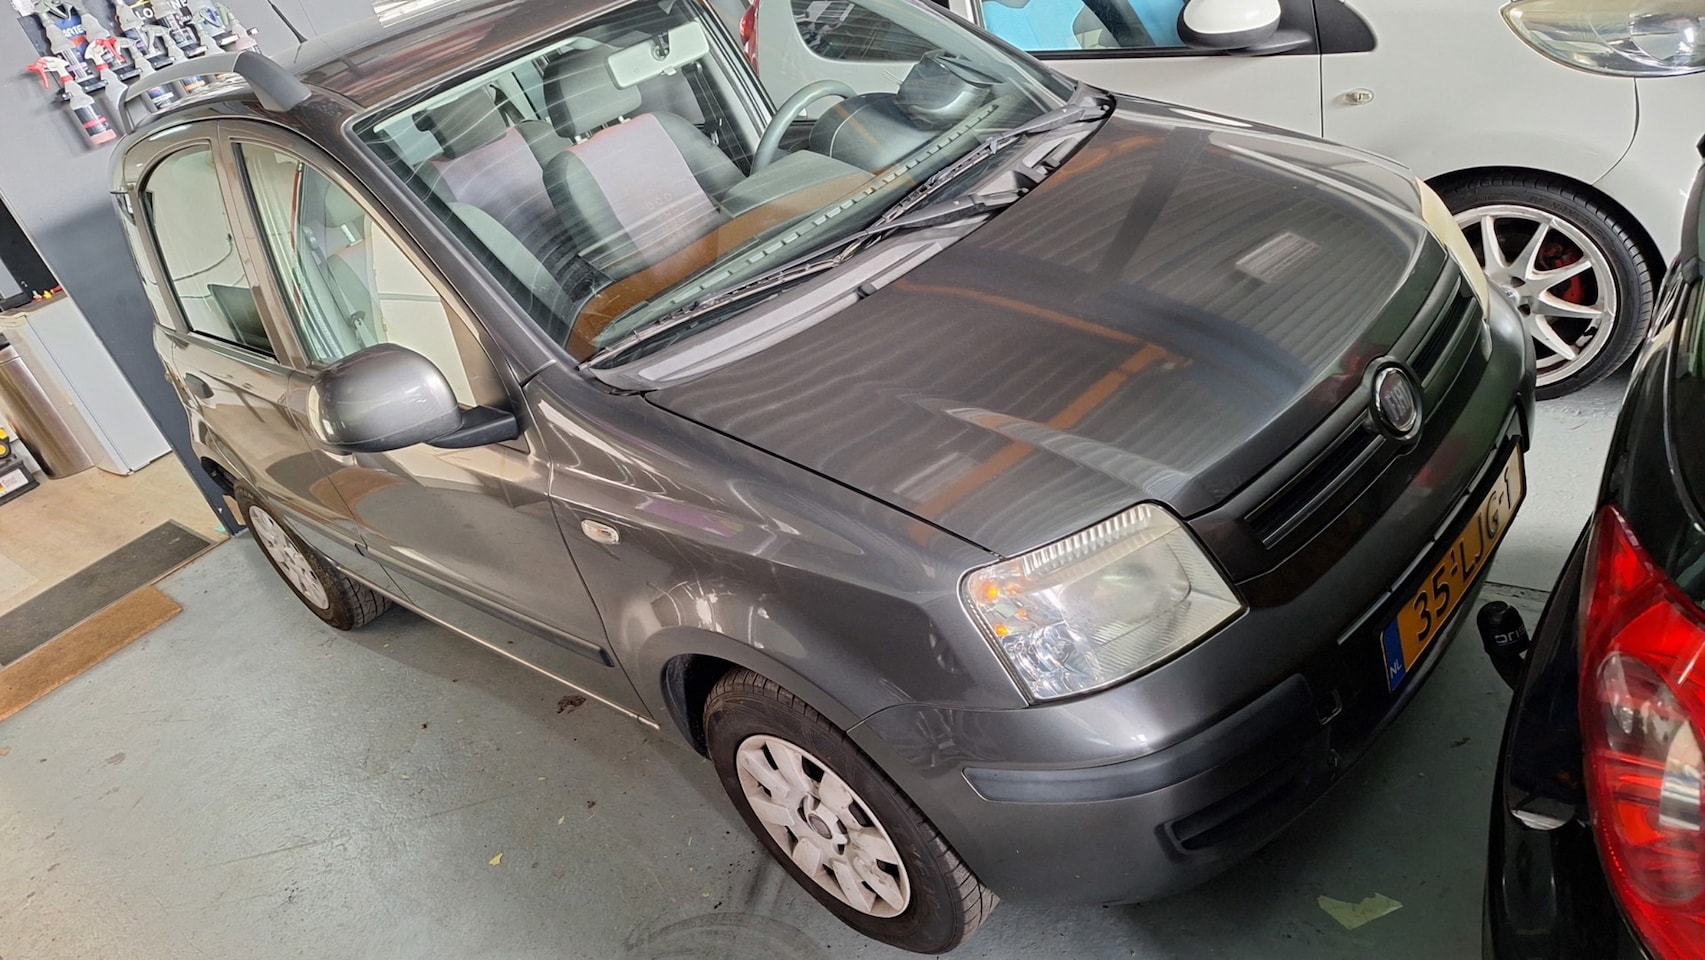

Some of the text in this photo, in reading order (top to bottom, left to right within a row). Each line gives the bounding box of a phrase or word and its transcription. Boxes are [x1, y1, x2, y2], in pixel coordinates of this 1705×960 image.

[1384, 381, 1411, 420] FIAT
[1414, 466, 1511, 643] 35-LJG-1
[1390, 658, 1403, 679] NL
